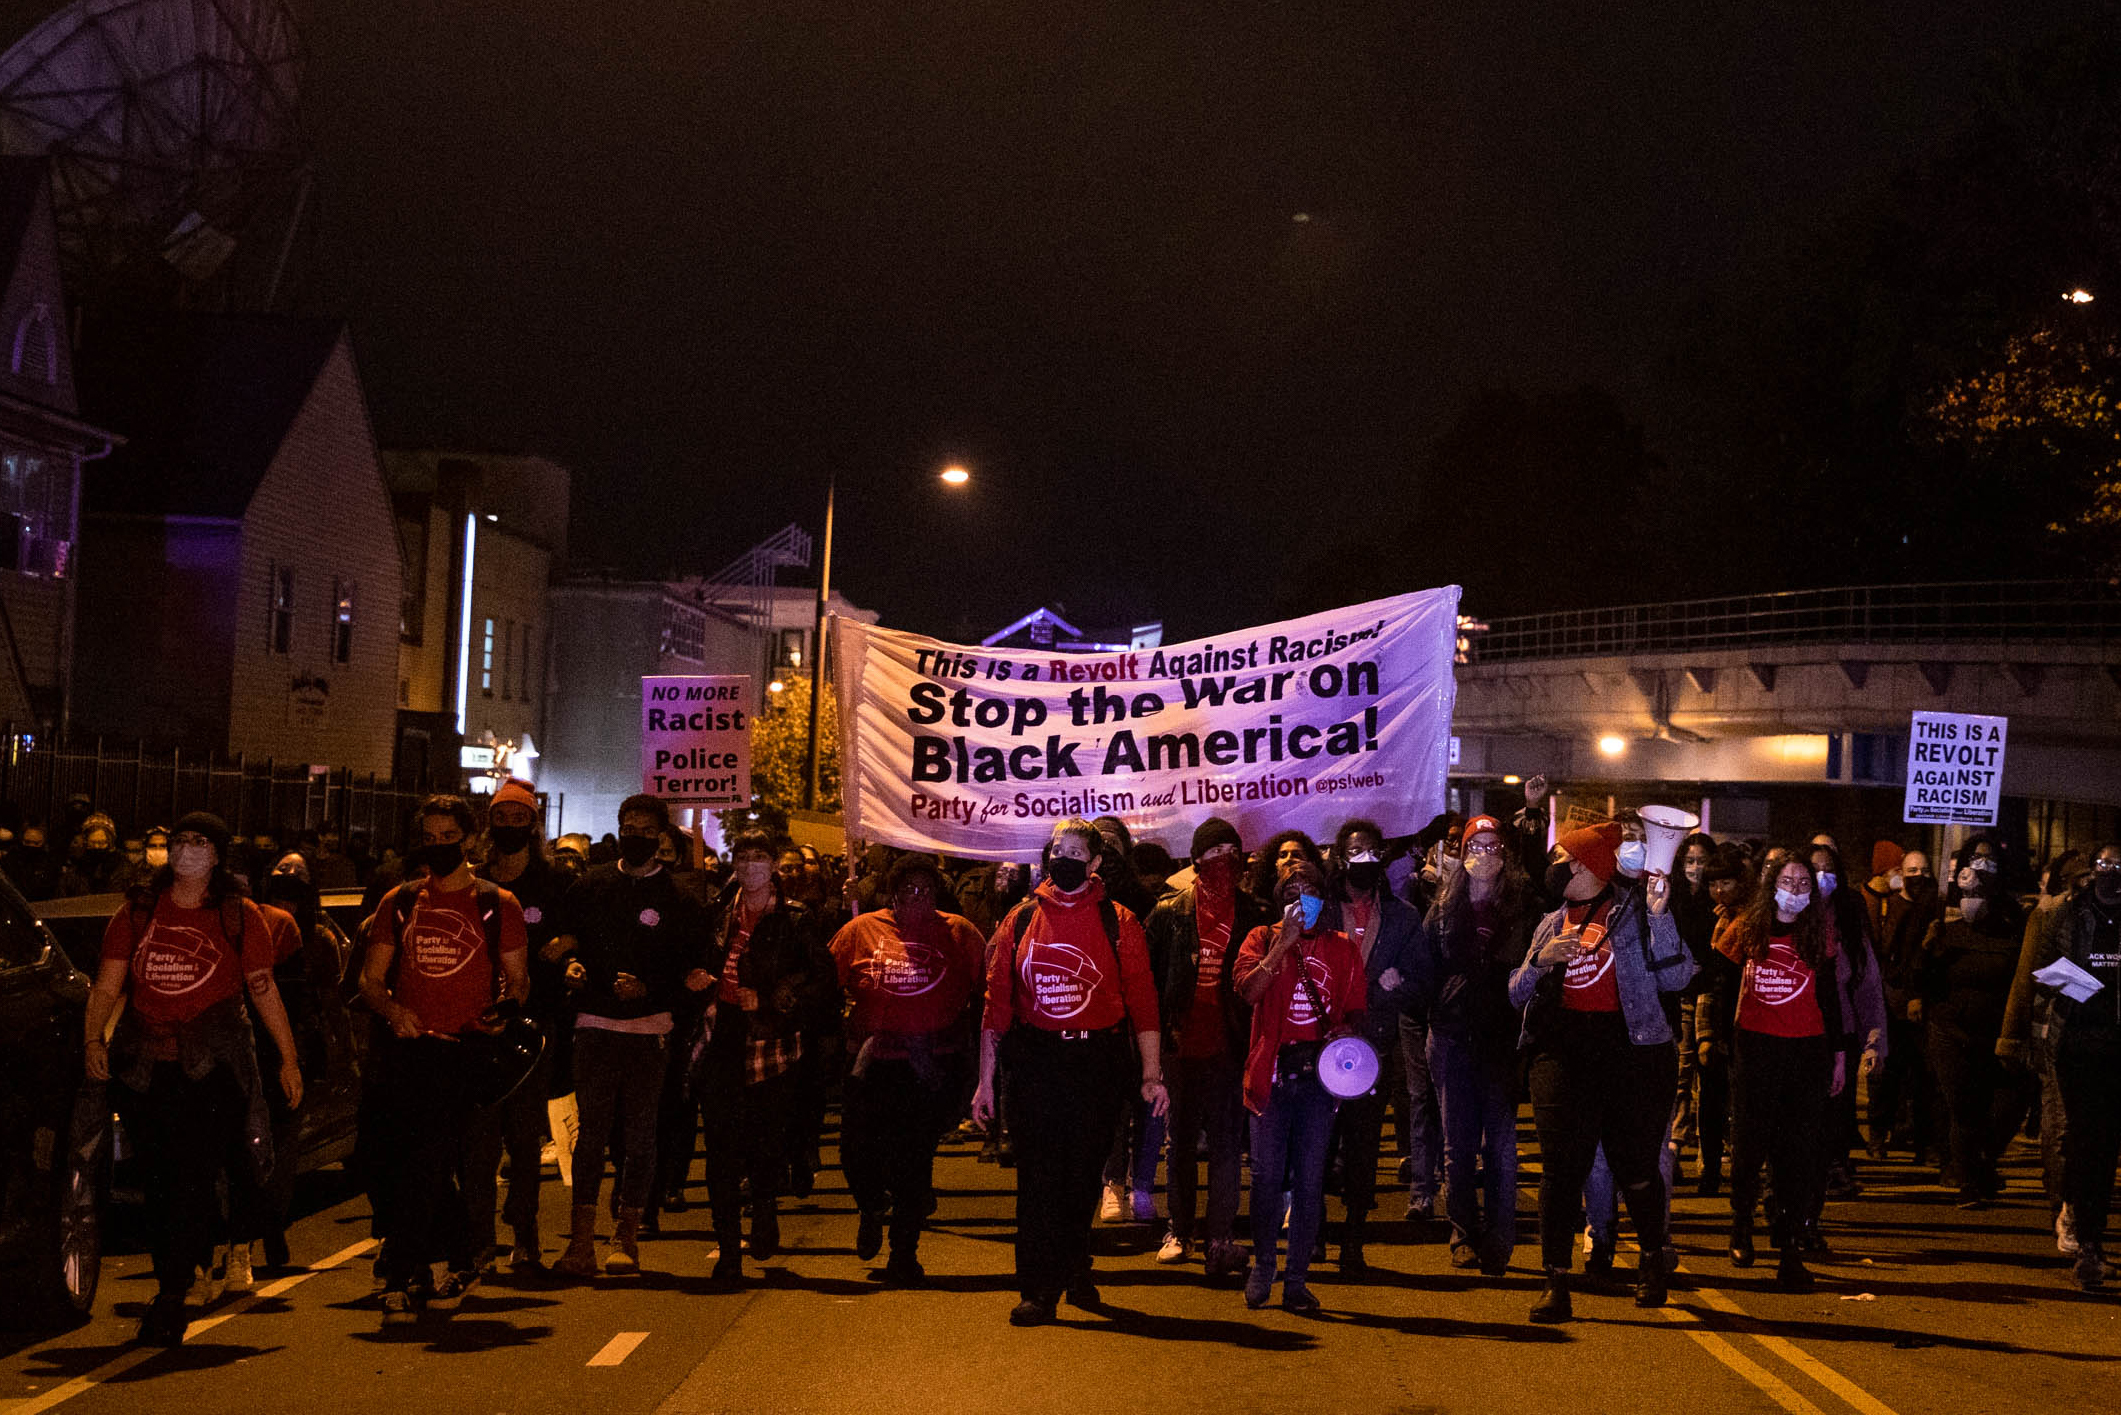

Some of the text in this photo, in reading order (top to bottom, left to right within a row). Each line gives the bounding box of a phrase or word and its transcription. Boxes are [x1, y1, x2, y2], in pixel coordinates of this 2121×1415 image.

[914, 619, 1386, 682] This is a Revolt Against Racism!
[651, 686, 740, 701] NO MORE
[907, 662, 1379, 735] Stop the War on
[648, 706, 746, 731] Racist
[1917, 721, 2000, 742] THIS IS A
[911, 706, 1378, 784] Black America!
[655, 748, 739, 770] Police
[1914, 742, 1999, 767] REVOLT
[653, 774, 738, 793] Terror!
[1912, 769, 1995, 787] AGAINST
[911, 794, 977, 826] Party
[980, 796, 1009, 824] for
[1014, 788, 1135, 818] Socialism
[1140, 784, 1177, 807] and
[1181, 773, 1309, 805] Liberation
[1916, 788, 1988, 806] RACISM
[416, 935, 441, 946] Party
[148, 951, 176, 964] Party
[416, 945, 457, 956] Socialism
[416, 954, 458, 966] Liberation
[146, 962, 194, 973] Socialism
[1755, 965, 1778, 977] Party
[145, 971, 195, 981] Liberation
[883, 974, 929, 984] Liberation
[1035, 972, 1060, 984] Party
[1754, 974, 1792, 985] Socialism
[1035, 982, 1078, 995] Socialism
[1754, 983, 1793, 993] Liberation
